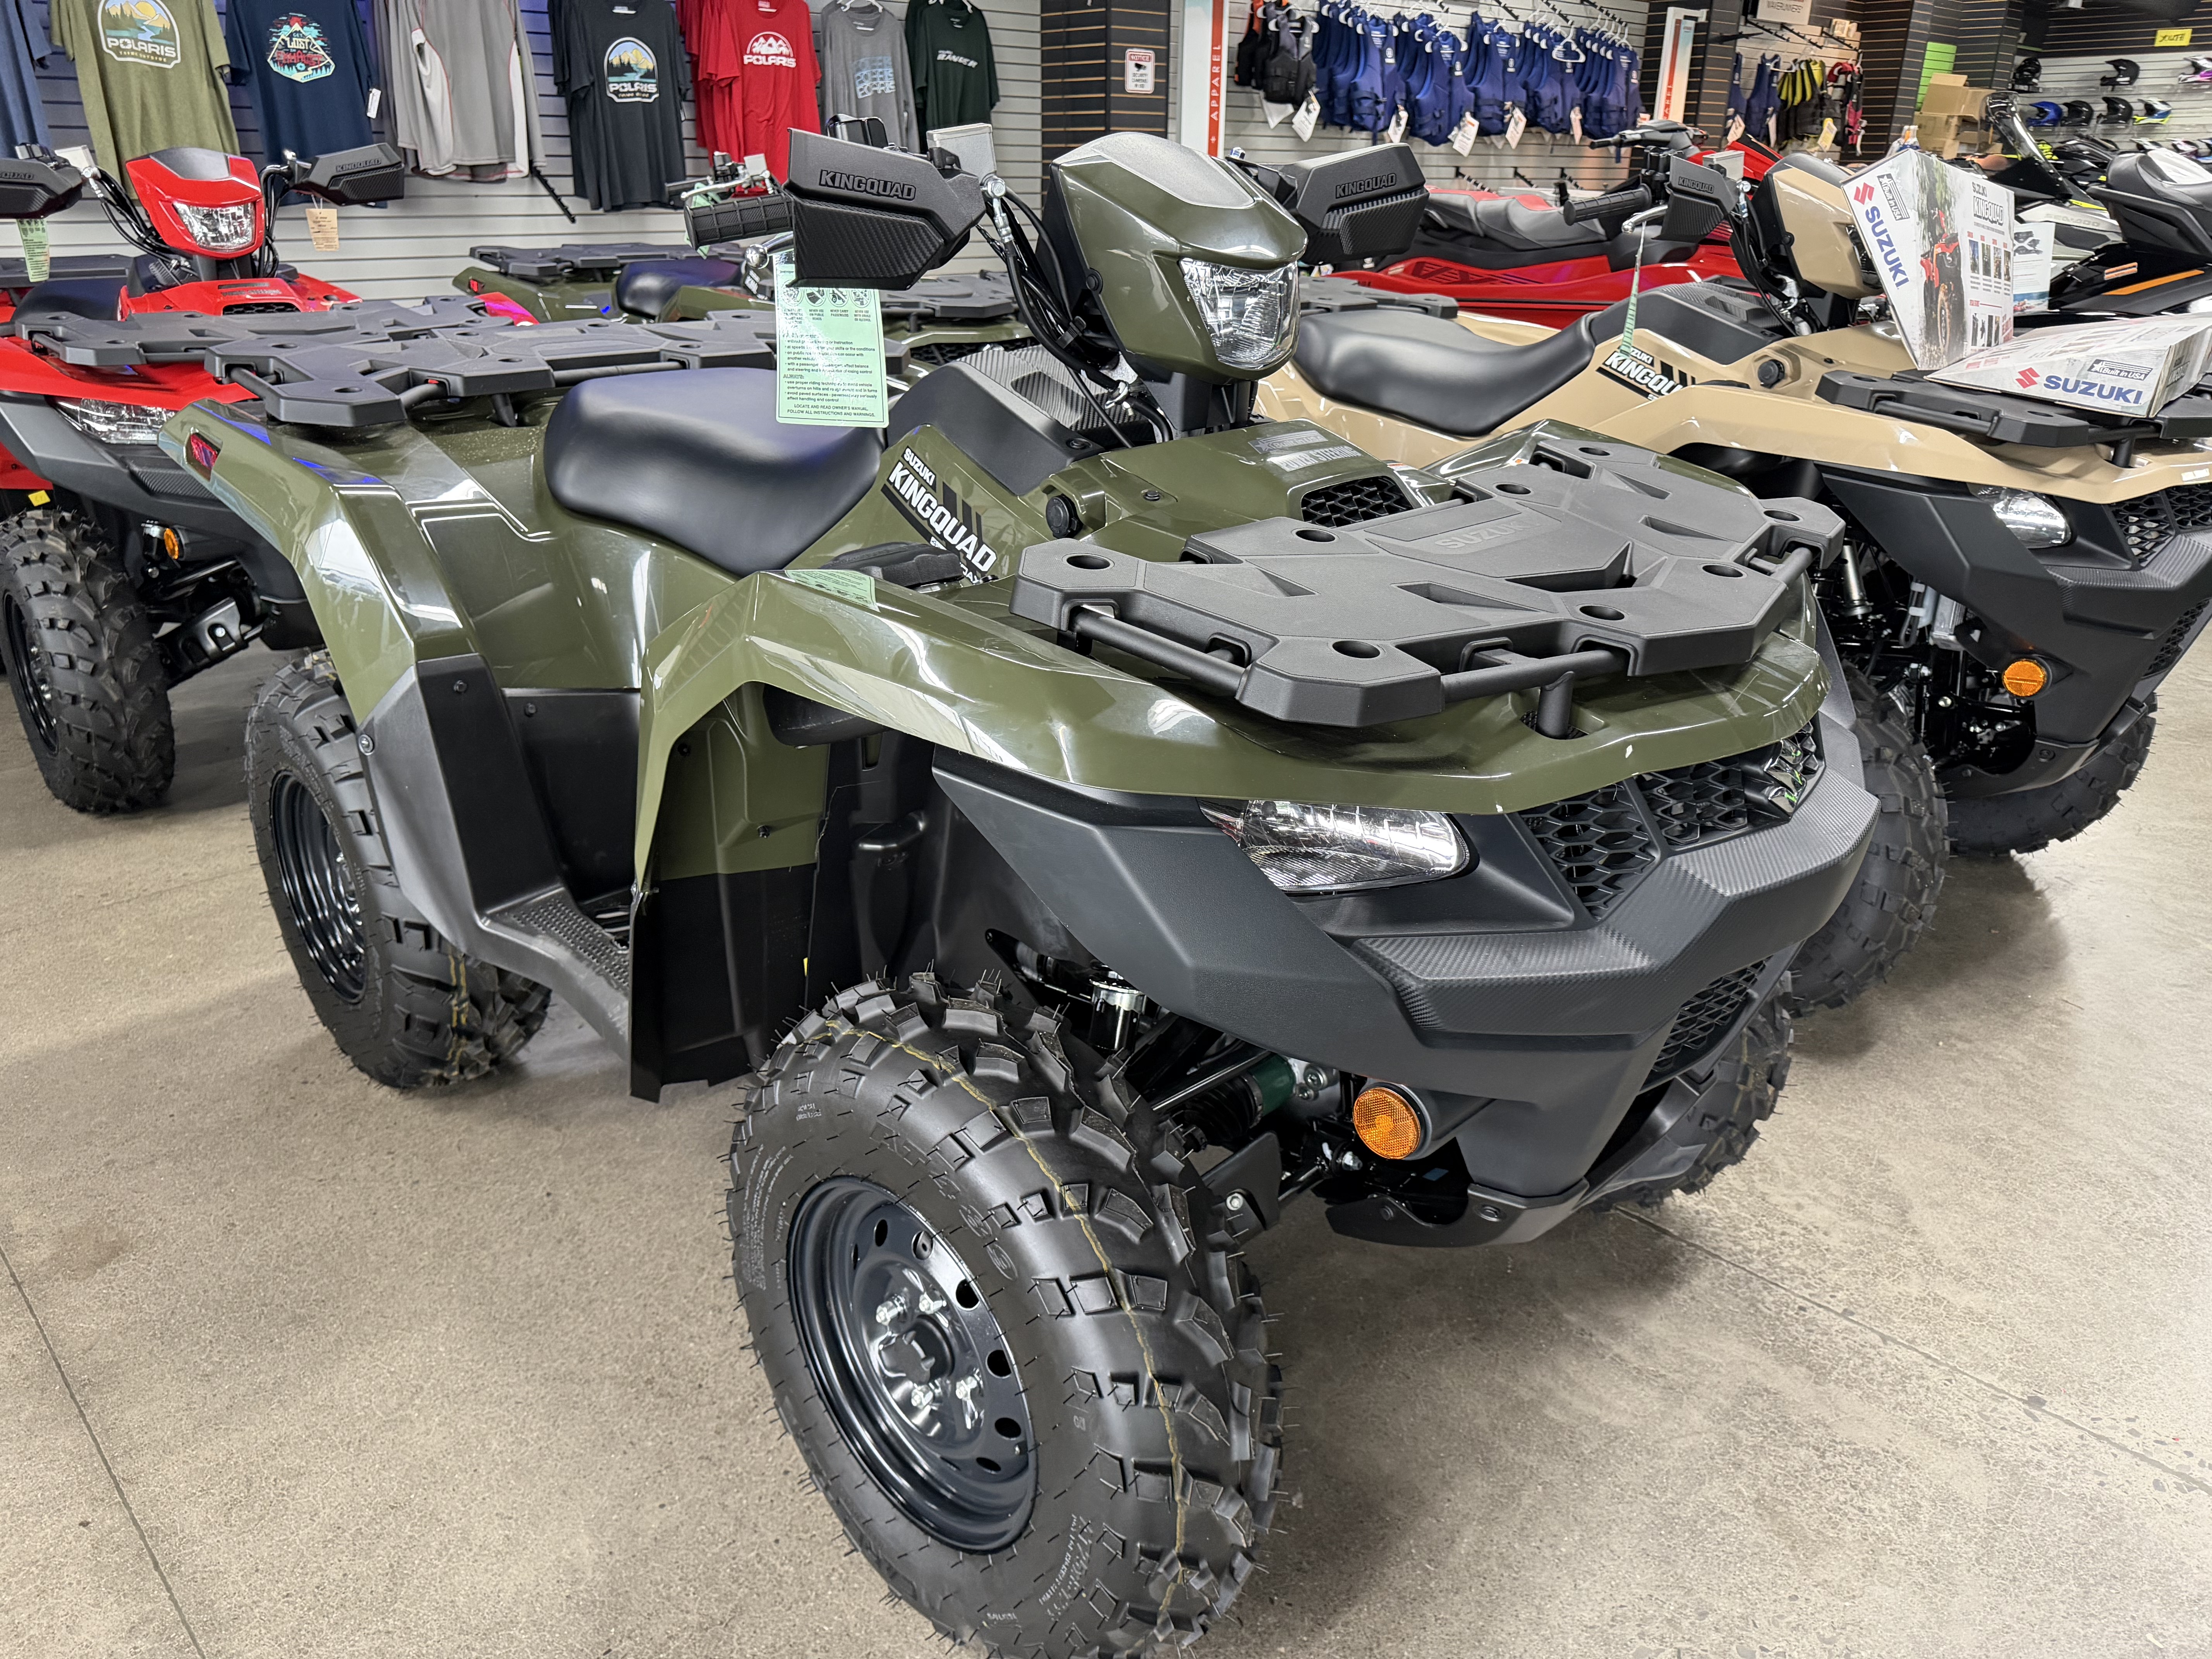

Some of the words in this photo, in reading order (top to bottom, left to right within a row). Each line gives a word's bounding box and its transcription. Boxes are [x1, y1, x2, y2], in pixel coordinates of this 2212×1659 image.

[107, 38, 176, 57] POLARIS
[743, 55, 796, 68] POLARIS
[937, 54, 978, 68] RANGER
[609, 82, 657, 93] POLARIS
[856, 80, 896, 99] POLARIS
[1210, 45, 1221, 121] APPAREL
[0, 172, 34, 180] QUAD
[819, 170, 916, 201] KINGQUAD
[1336, 173, 1396, 199] KINGQUAD
[1678, 177, 1714, 194] KINGQUAD
[1882, 185, 1893, 200] Built
[1891, 206, 1902, 220] USA
[1973, 196, 2004, 226] KINGQUAD
[1865, 206, 1909, 287] SUZUKI
[1630, 347, 1653, 364] ZUKI
[1604, 352, 1683, 395] KINGQU
[2044, 375, 2143, 405] SUZUKI
[904, 448, 935, 486] SUZUKI
[1309, 446, 1362, 462] STEERING
[889, 462, 997, 572] KINGQUAD
